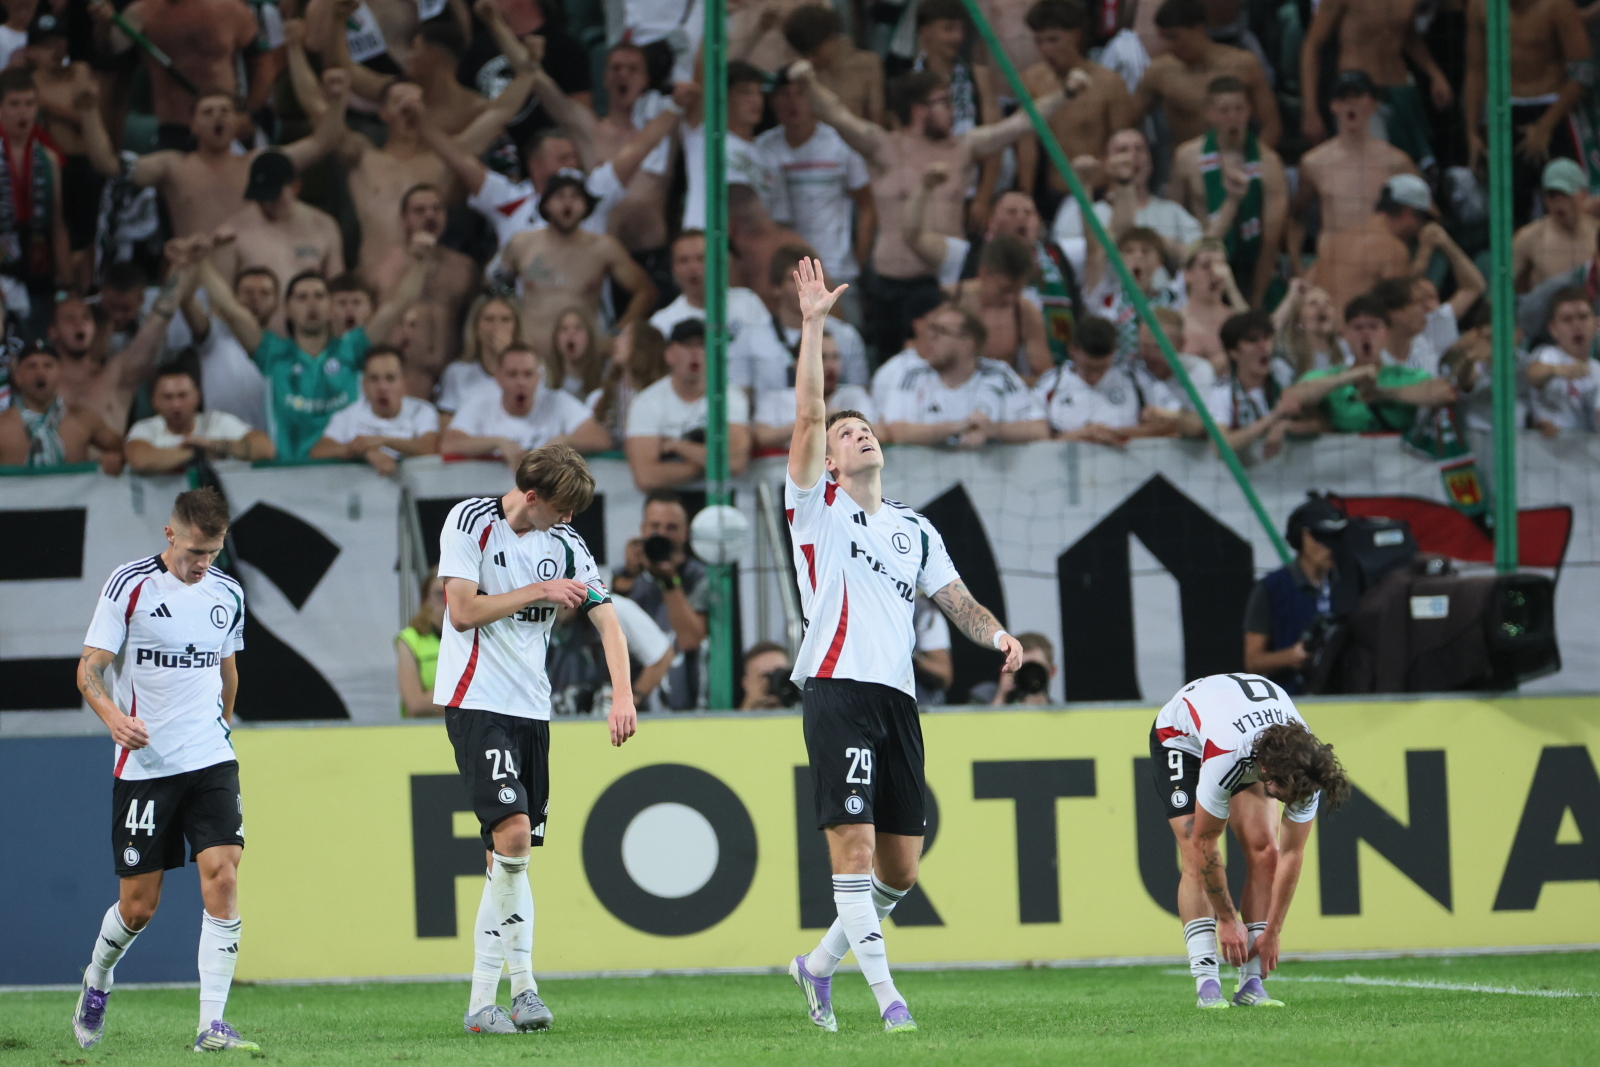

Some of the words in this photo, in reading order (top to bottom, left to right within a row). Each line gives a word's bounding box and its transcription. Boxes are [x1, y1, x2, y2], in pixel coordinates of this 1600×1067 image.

[1232, 708, 1288, 735] ARELA
[485, 748, 518, 781] 24
[845, 747, 872, 785] 29
[1167, 749, 1184, 782] 9
[125, 798, 156, 837] 44
